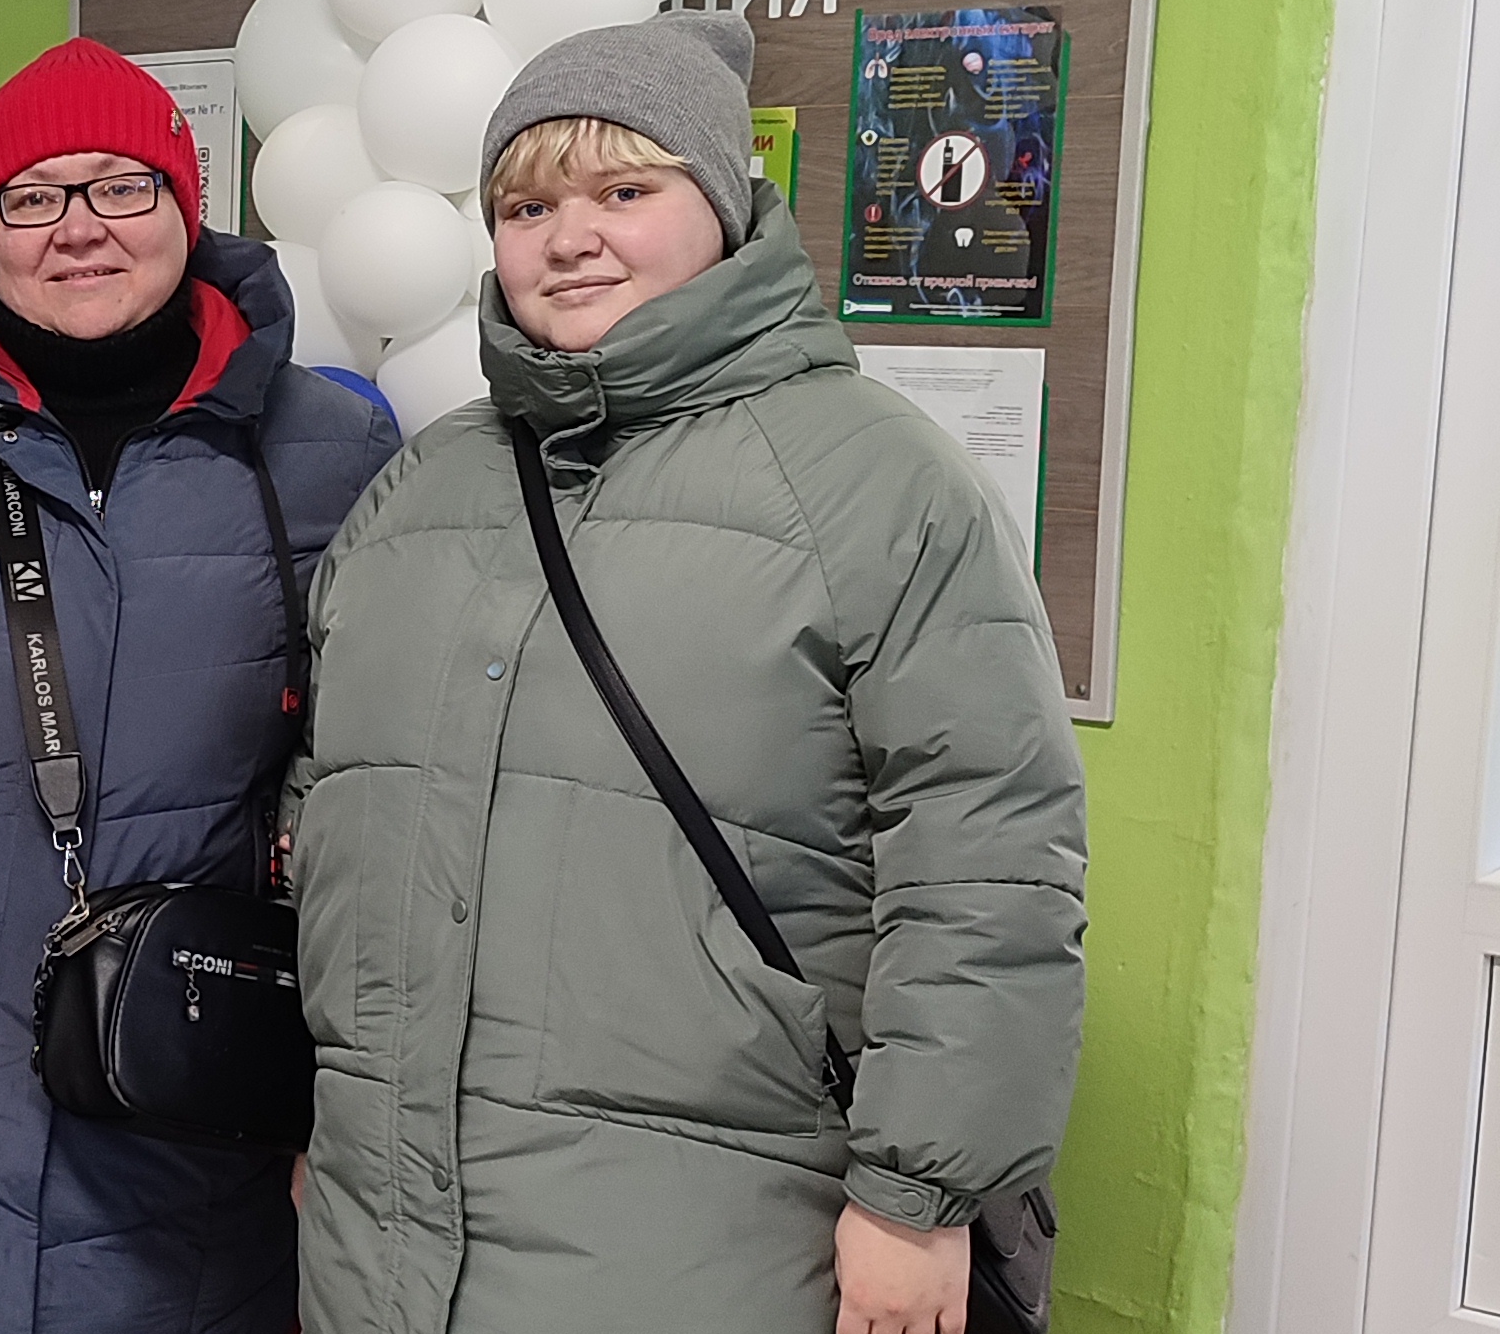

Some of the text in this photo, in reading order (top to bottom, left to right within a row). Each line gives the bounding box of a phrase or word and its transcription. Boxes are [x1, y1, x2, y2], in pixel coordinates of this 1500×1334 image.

[852, 273, 908, 287] Откажись
[909, 275, 923, 287] от
[924, 274, 974, 290] вредной
[26, 633, 53, 707] KARLOS
